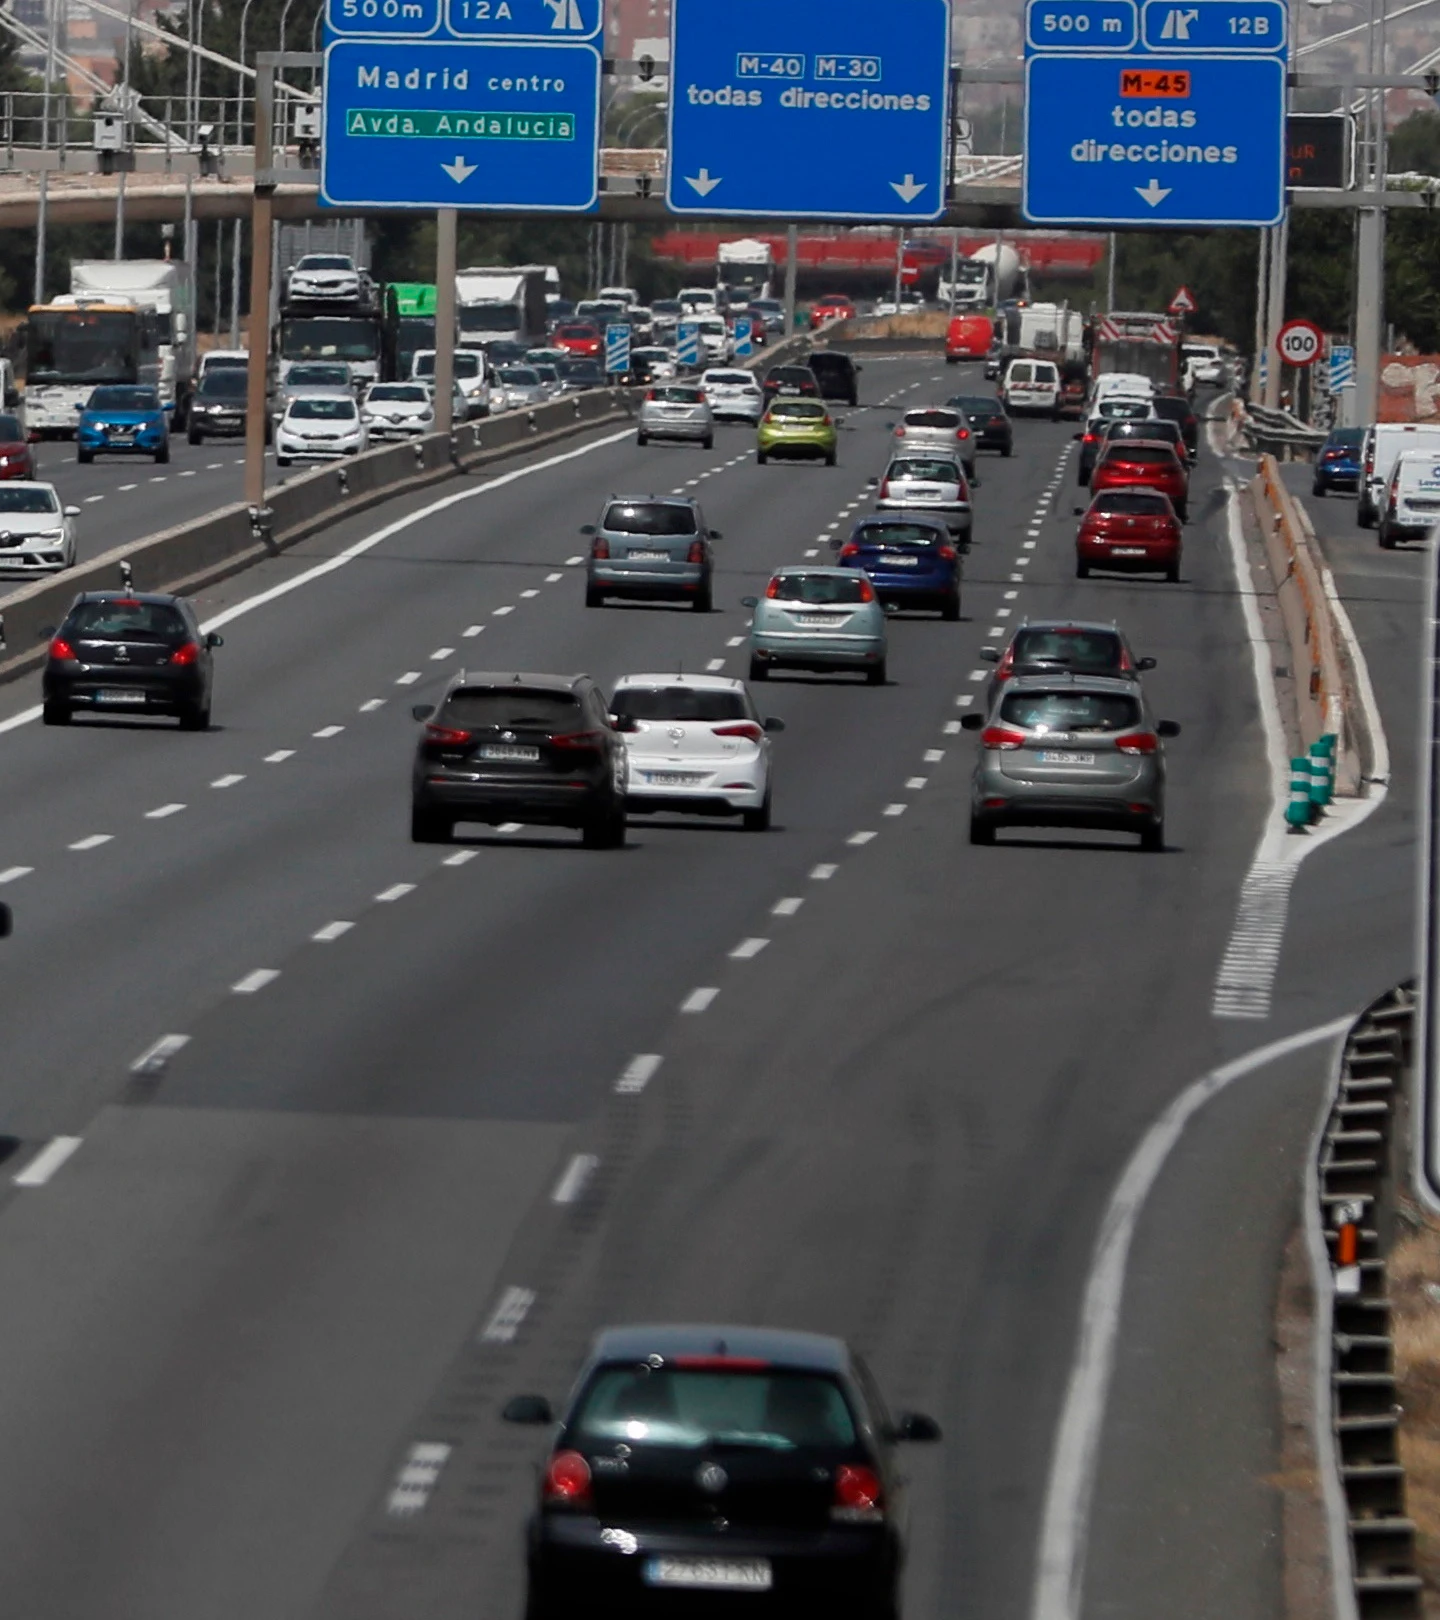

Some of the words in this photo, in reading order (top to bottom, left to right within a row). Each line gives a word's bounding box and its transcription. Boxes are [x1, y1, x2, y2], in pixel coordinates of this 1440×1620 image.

[462, 0, 512, 20] 12A
[1043, 15, 1090, 33] 500
[1103, 19, 1122, 33] m
[1228, 17, 1270, 36] 12B
[740, 56, 801, 76] M-40
[817, 58, 878, 77] M-30
[357, 65, 469, 91] Madrid
[487, 74, 566, 93] centro
[1122, 74, 1187, 94] M-45
[687, 84, 763, 107] todas
[779, 87, 931, 112] direcciones
[350, 112, 421, 135] Avda.
[1112, 105, 1197, 128] todas
[1070, 139, 1238, 164] direcciones
[1284, 335, 1315, 352] 100
